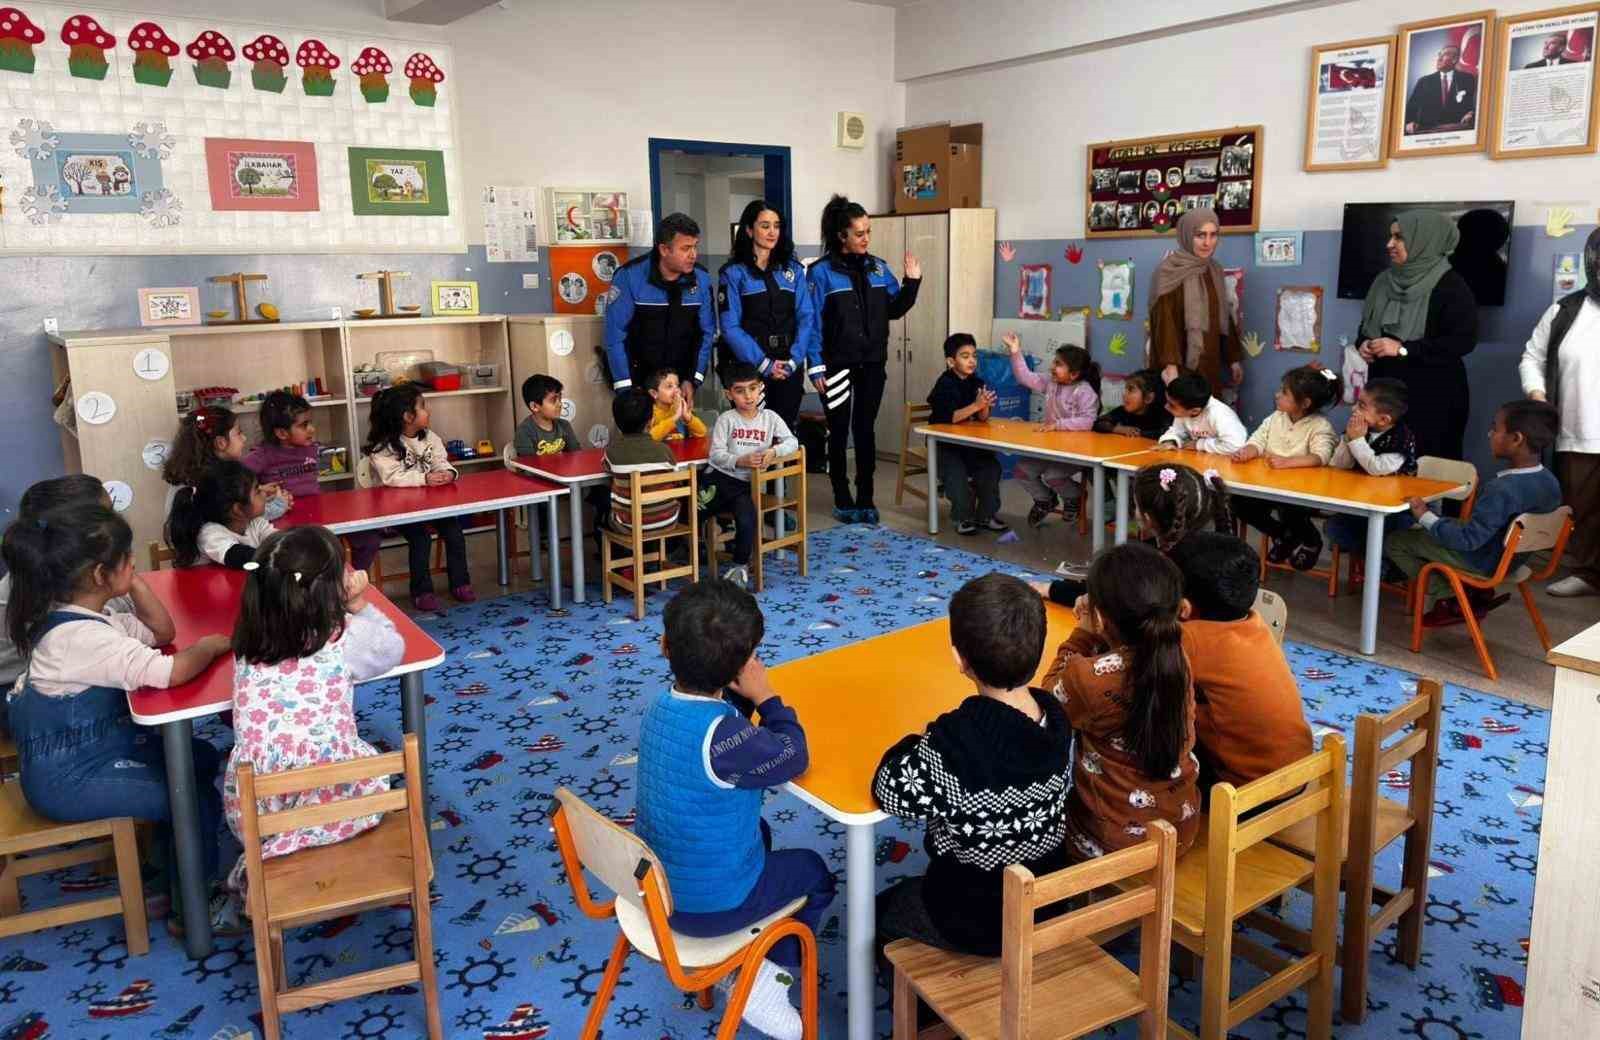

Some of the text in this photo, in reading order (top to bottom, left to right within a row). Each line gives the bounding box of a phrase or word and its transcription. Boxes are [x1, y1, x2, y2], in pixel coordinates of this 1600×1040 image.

[244, 159, 282, 168] İLKBAHAR
[390, 167, 404, 175] YAZ
[556, 332, 568, 351] 1
[140, 353, 160, 372] 1
[86, 397, 111, 420] 2
[561, 401, 570, 417] 3
[149, 444, 165, 466] 3
